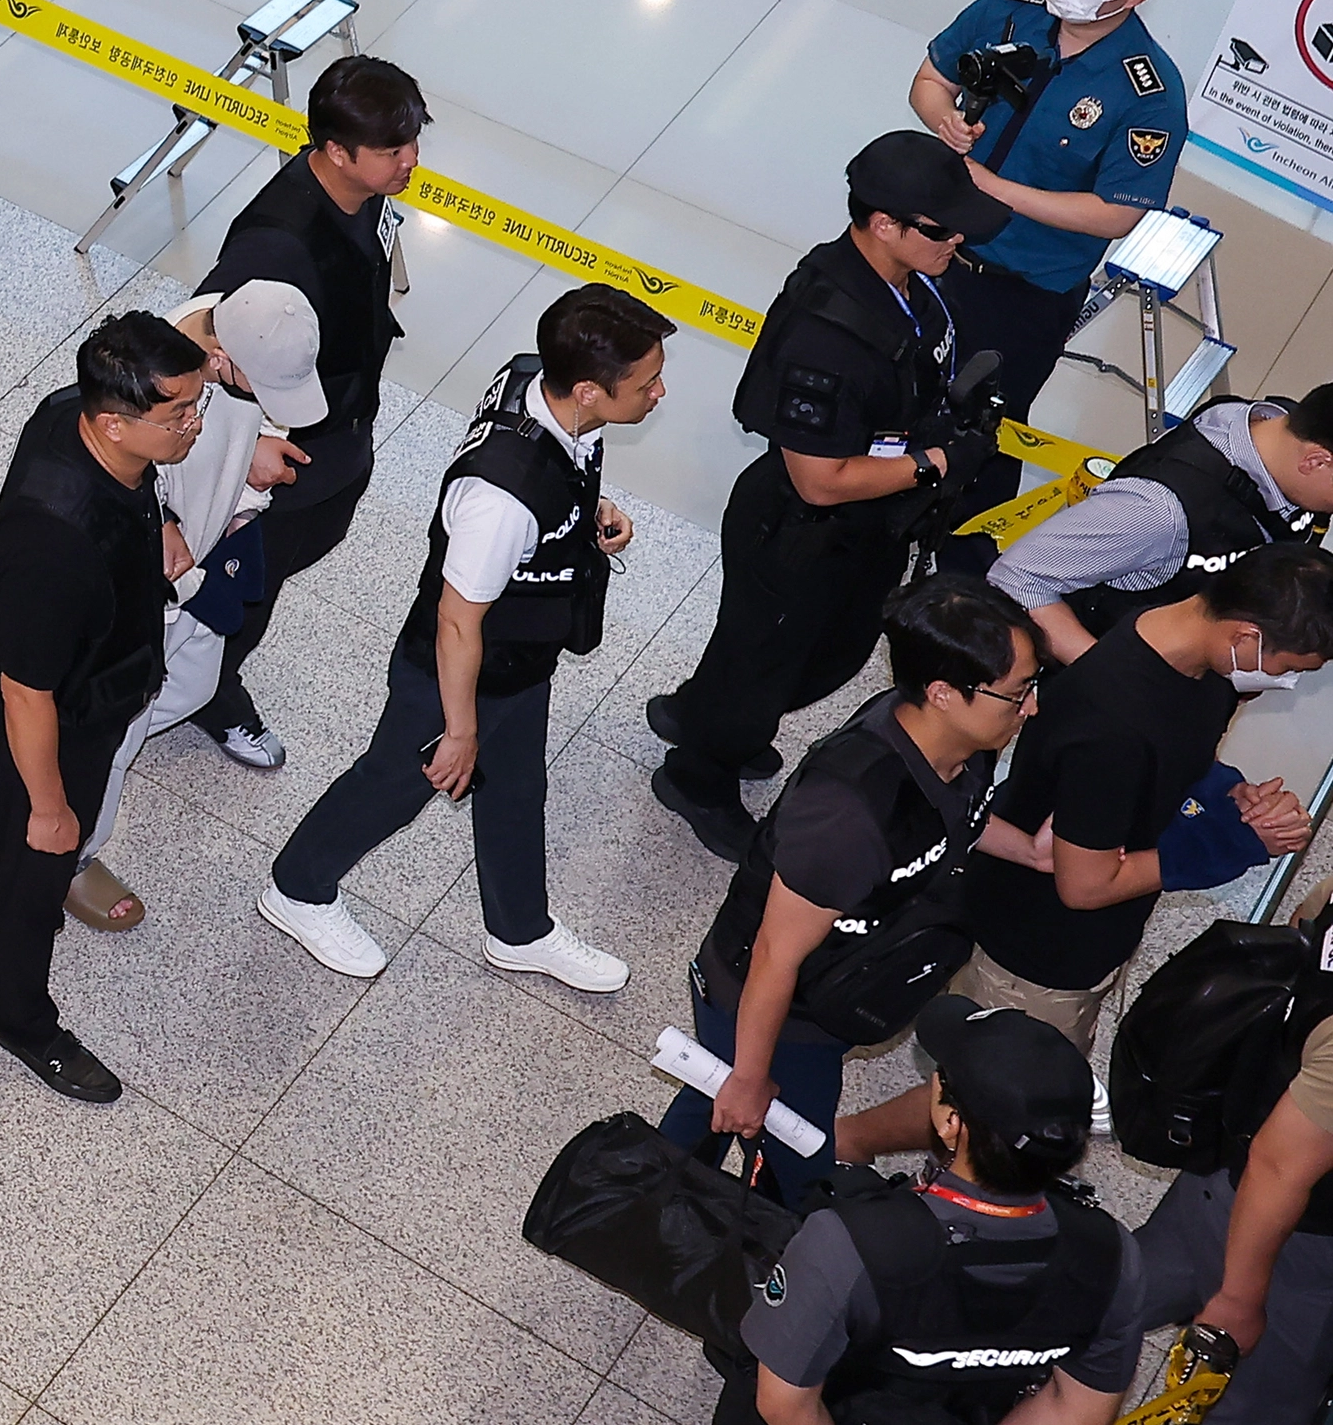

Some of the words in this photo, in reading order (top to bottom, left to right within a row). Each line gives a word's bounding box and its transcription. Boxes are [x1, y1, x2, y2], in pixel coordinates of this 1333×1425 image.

[1208, 86, 1218, 98] In
[1219, 91, 1234, 106] the
[1235, 101, 1261, 119] event
[1261, 112, 1273, 124] of
[1273, 118, 1312, 145] violation,
[1232, 79, 1251, 96] 위반
[1252, 89, 1262, 103] 시
[1262, 94, 1281, 112] 관련
[1282, 102, 1310, 125] 법령에
[1309, 116, 1329, 135] 따라
[1271, 150, 1318, 181] Incheon
[512, 567, 575, 583] OLICE
